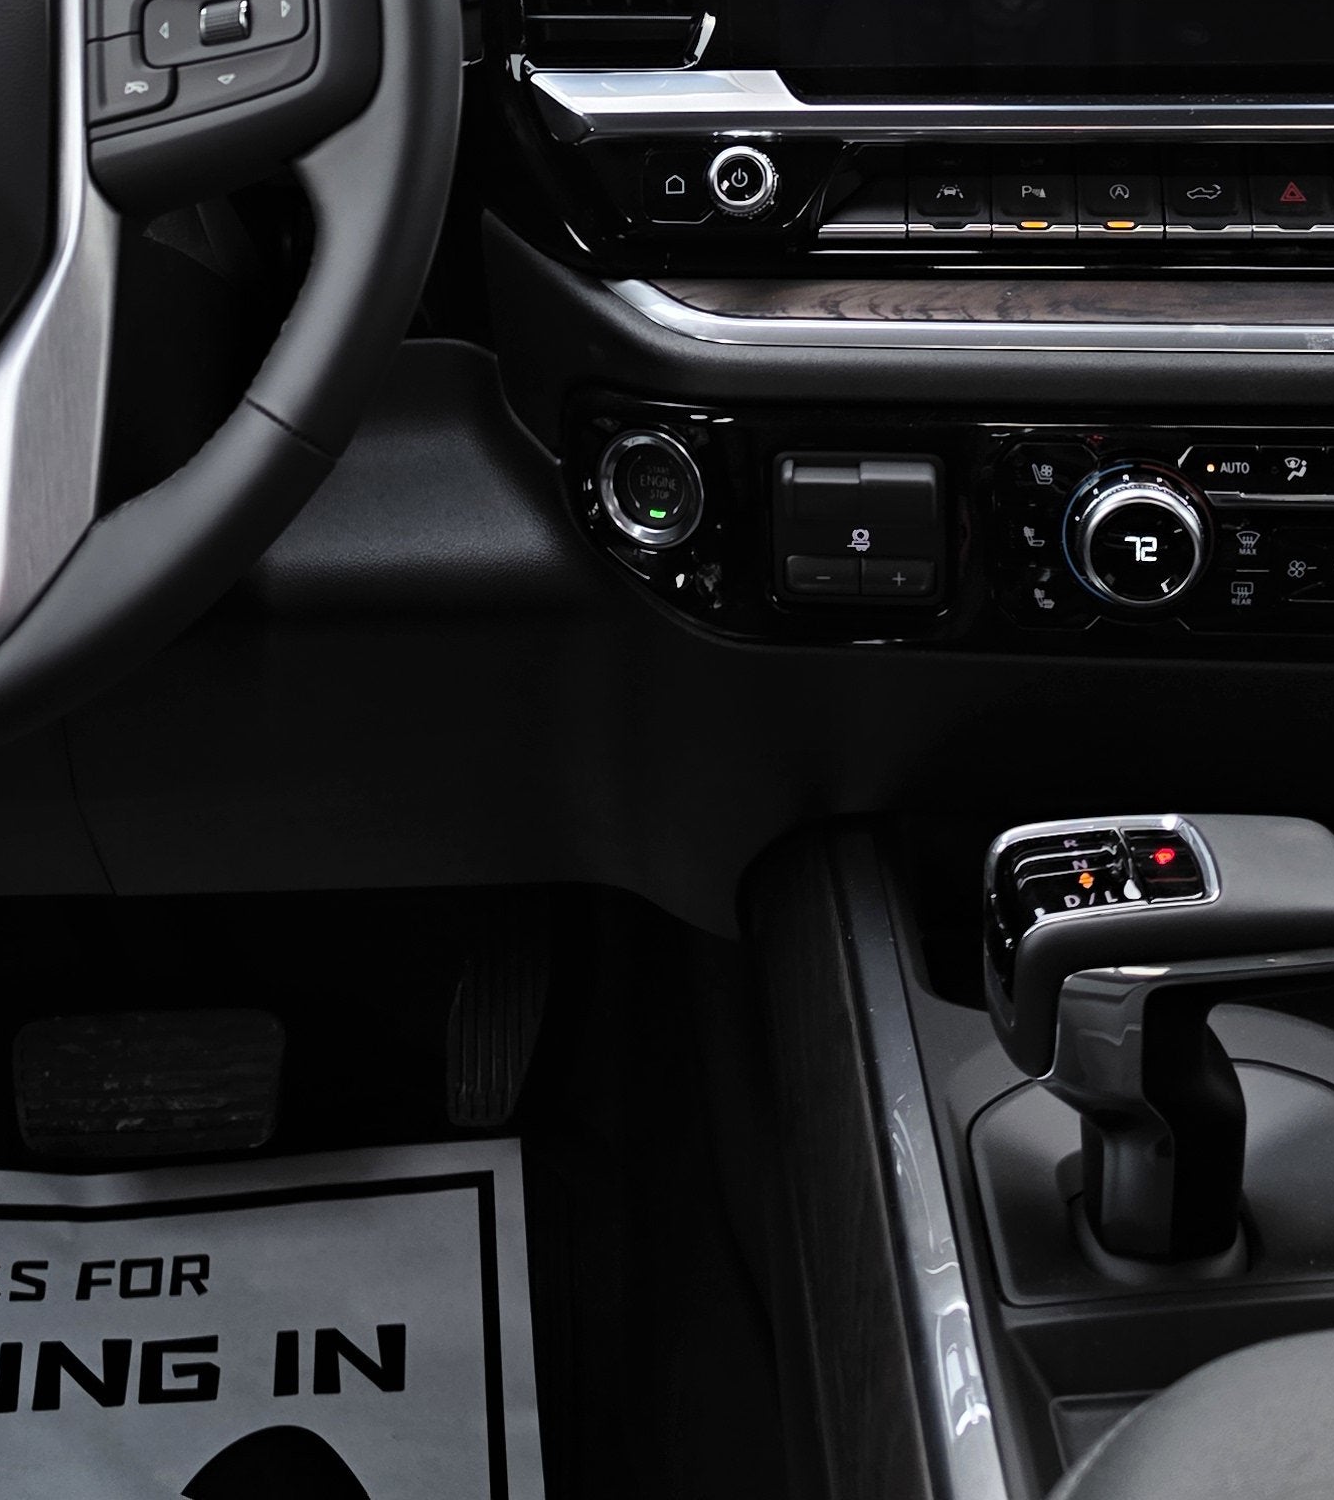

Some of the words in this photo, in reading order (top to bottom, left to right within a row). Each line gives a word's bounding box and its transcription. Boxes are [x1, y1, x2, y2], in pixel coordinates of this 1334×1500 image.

[1220, 463, 1251, 475] AUTO
[640, 474, 677, 491] ENGINE
[1124, 536, 1158, 562] 72
[1238, 547, 1258, 556] MAX
[1231, 597, 1252, 606] REAR
[1063, 839, 1078, 849] R
[1072, 859, 1089, 871] N
[74, 1252, 212, 1302] FOR
[273, 1323, 407, 1398] IN
